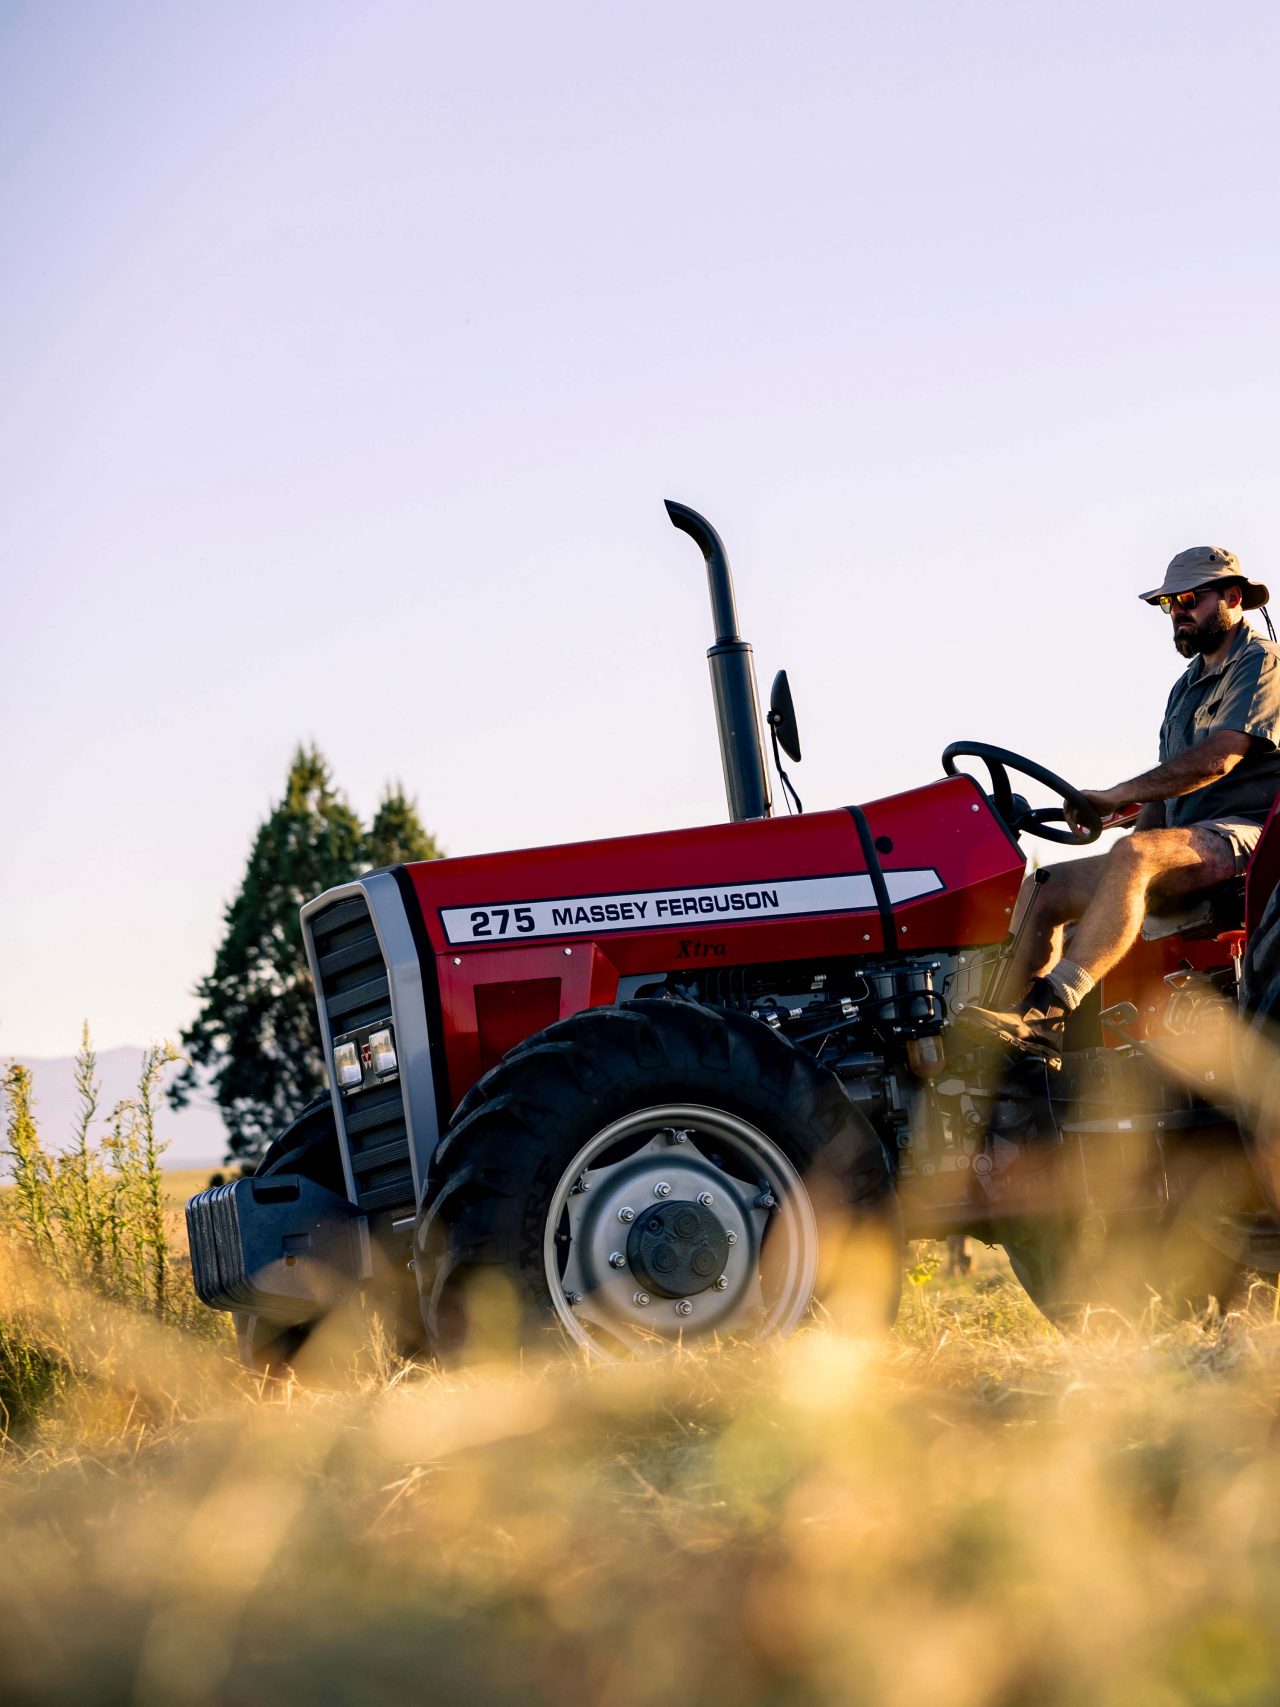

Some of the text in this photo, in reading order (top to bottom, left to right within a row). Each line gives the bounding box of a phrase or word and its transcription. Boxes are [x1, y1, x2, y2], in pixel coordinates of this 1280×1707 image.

[470, 889, 780, 937] 275 MASSEY FERGUSON
[676, 939, 727, 959] Xtra
[519, 1154, 554, 1270] MRF
